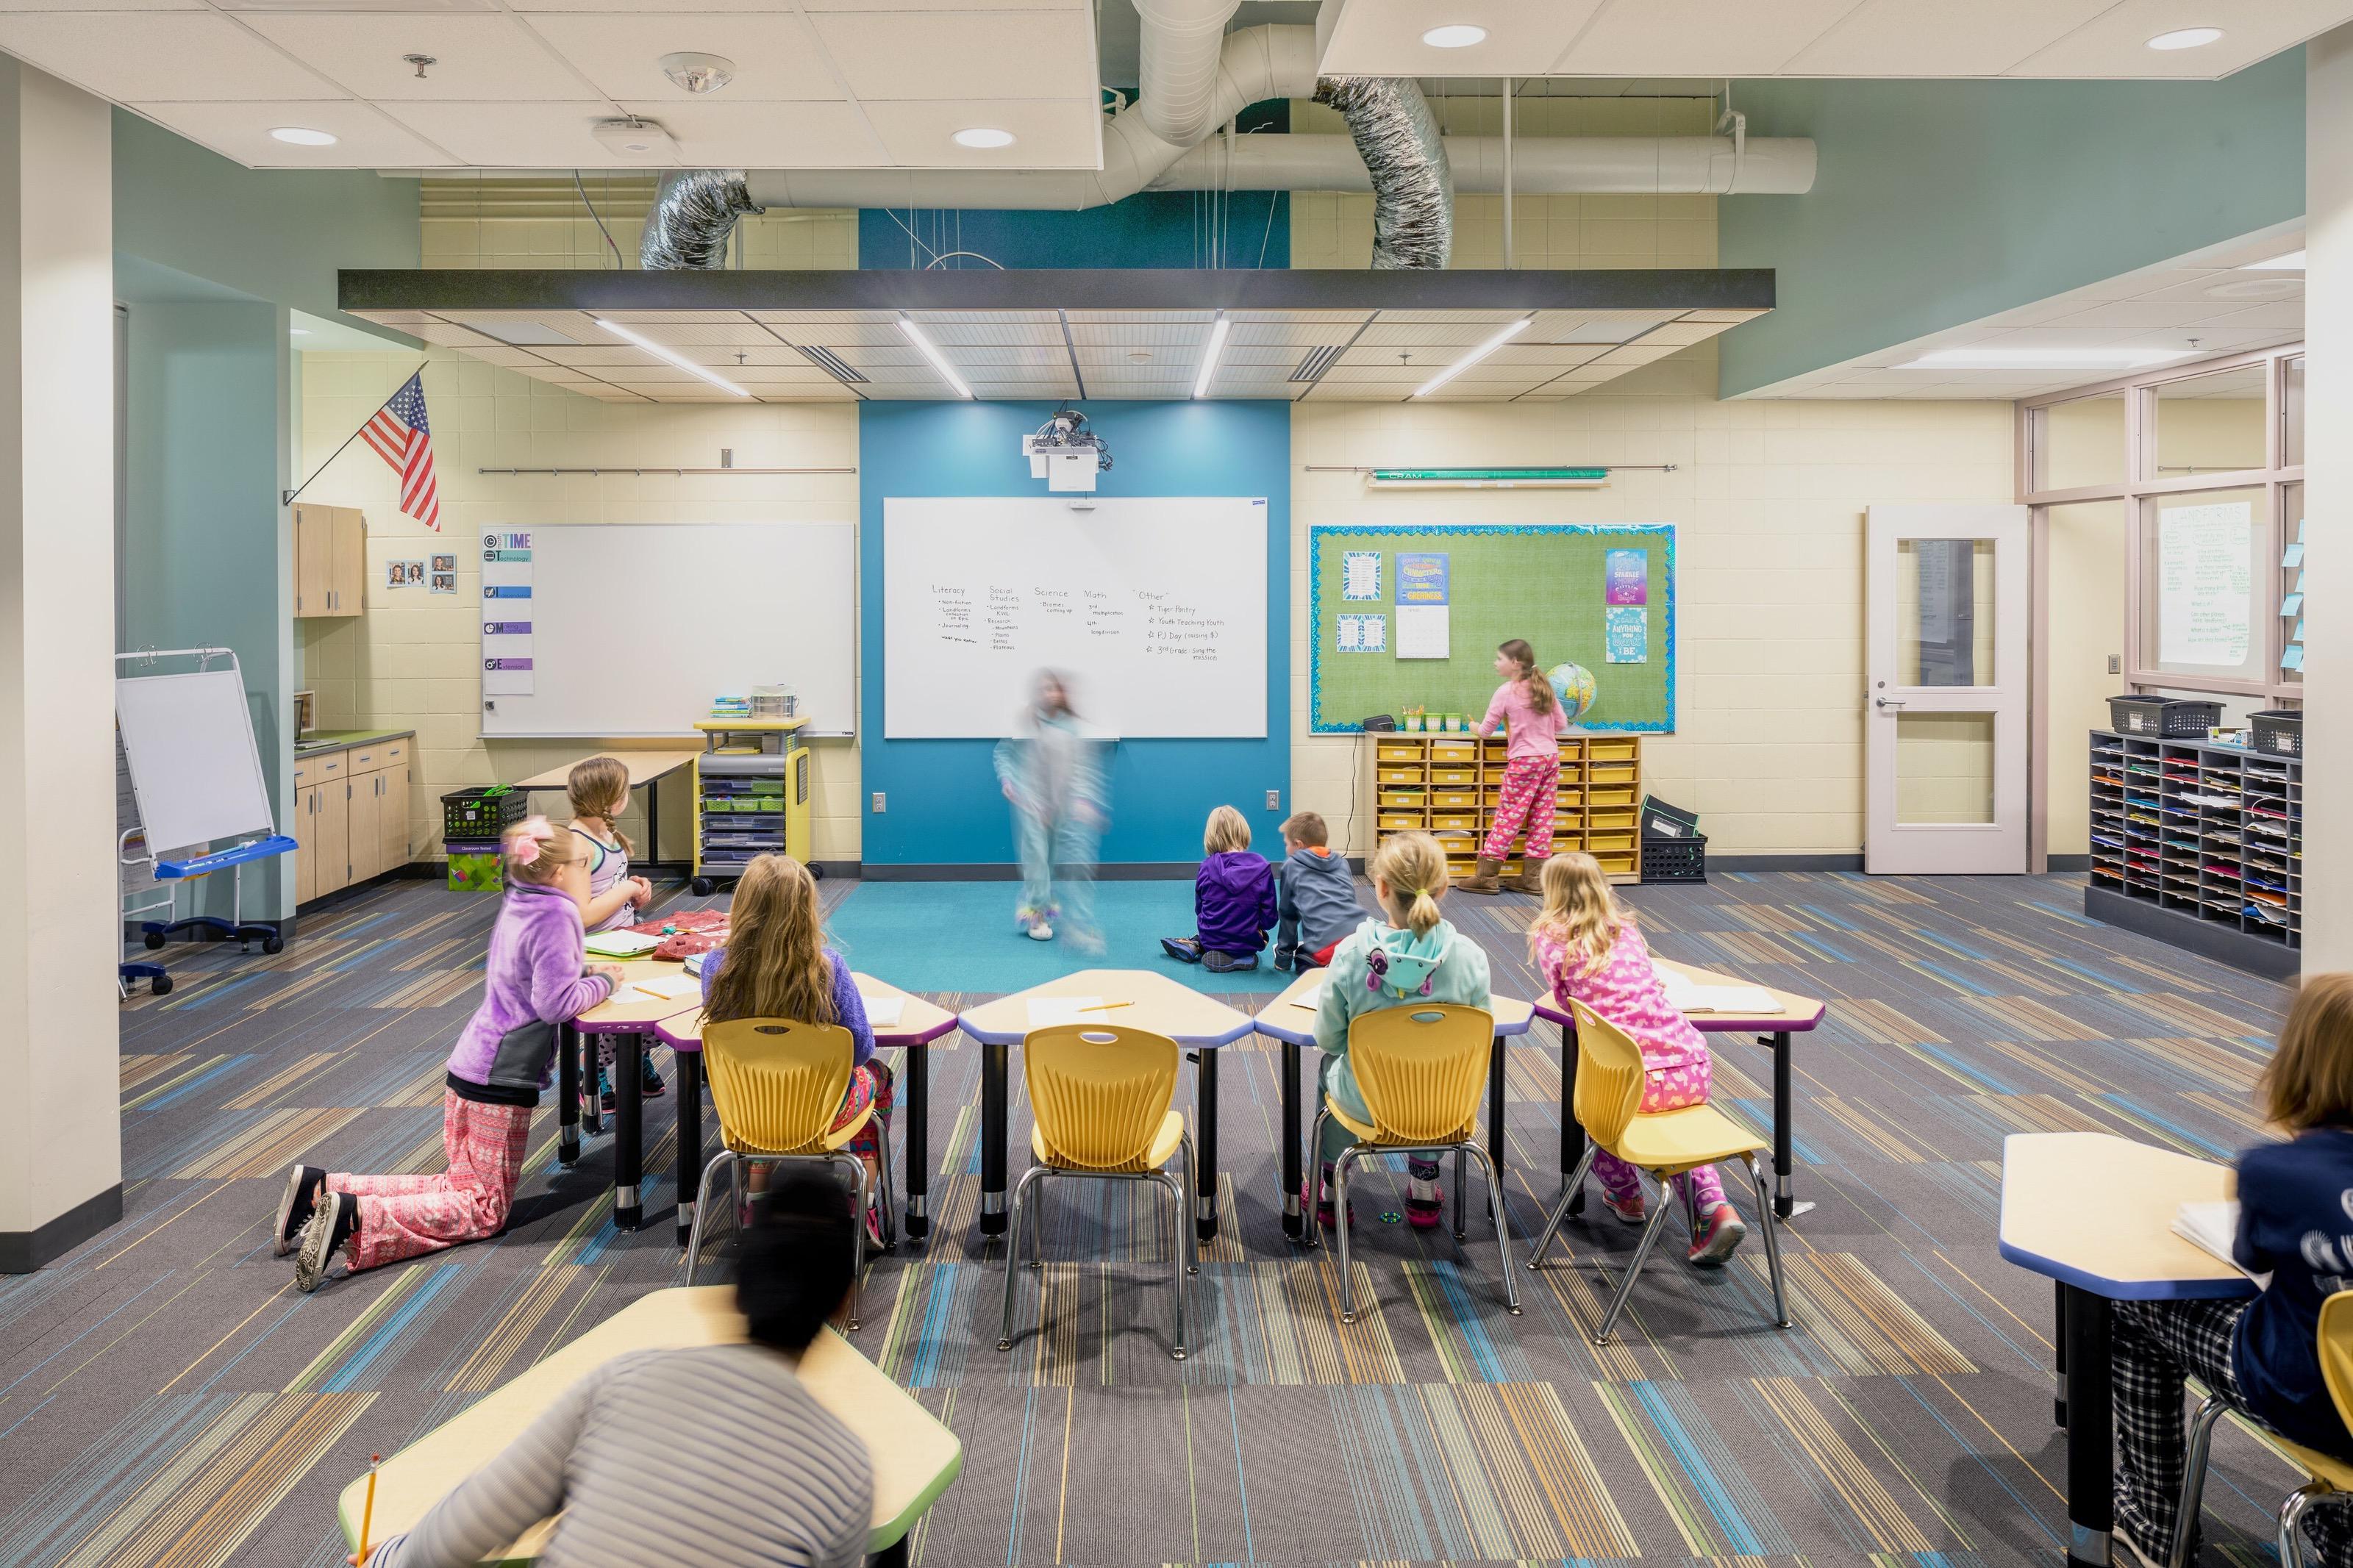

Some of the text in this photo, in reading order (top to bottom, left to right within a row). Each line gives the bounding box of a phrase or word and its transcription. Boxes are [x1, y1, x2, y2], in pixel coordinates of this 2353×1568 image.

[502, 533, 531, 548] TIME
[496, 550, 529, 562] Technology
[932, 584, 965, 597] Literacy
[990, 585, 1013, 594] Social
[1035, 587, 1070, 597] Science
[1084, 590, 1107, 598] Math
[990, 594, 1019, 602] Studies
[1157, 605, 1196, 617] Tiger Pantry
[1158, 617, 1175, 625] Youth
[1177, 618, 1205, 627] Teaching
[1613, 625, 1642, 633] ANYTHING
[1169, 631, 1182, 642] Day
[1623, 647, 1636, 655] BE
